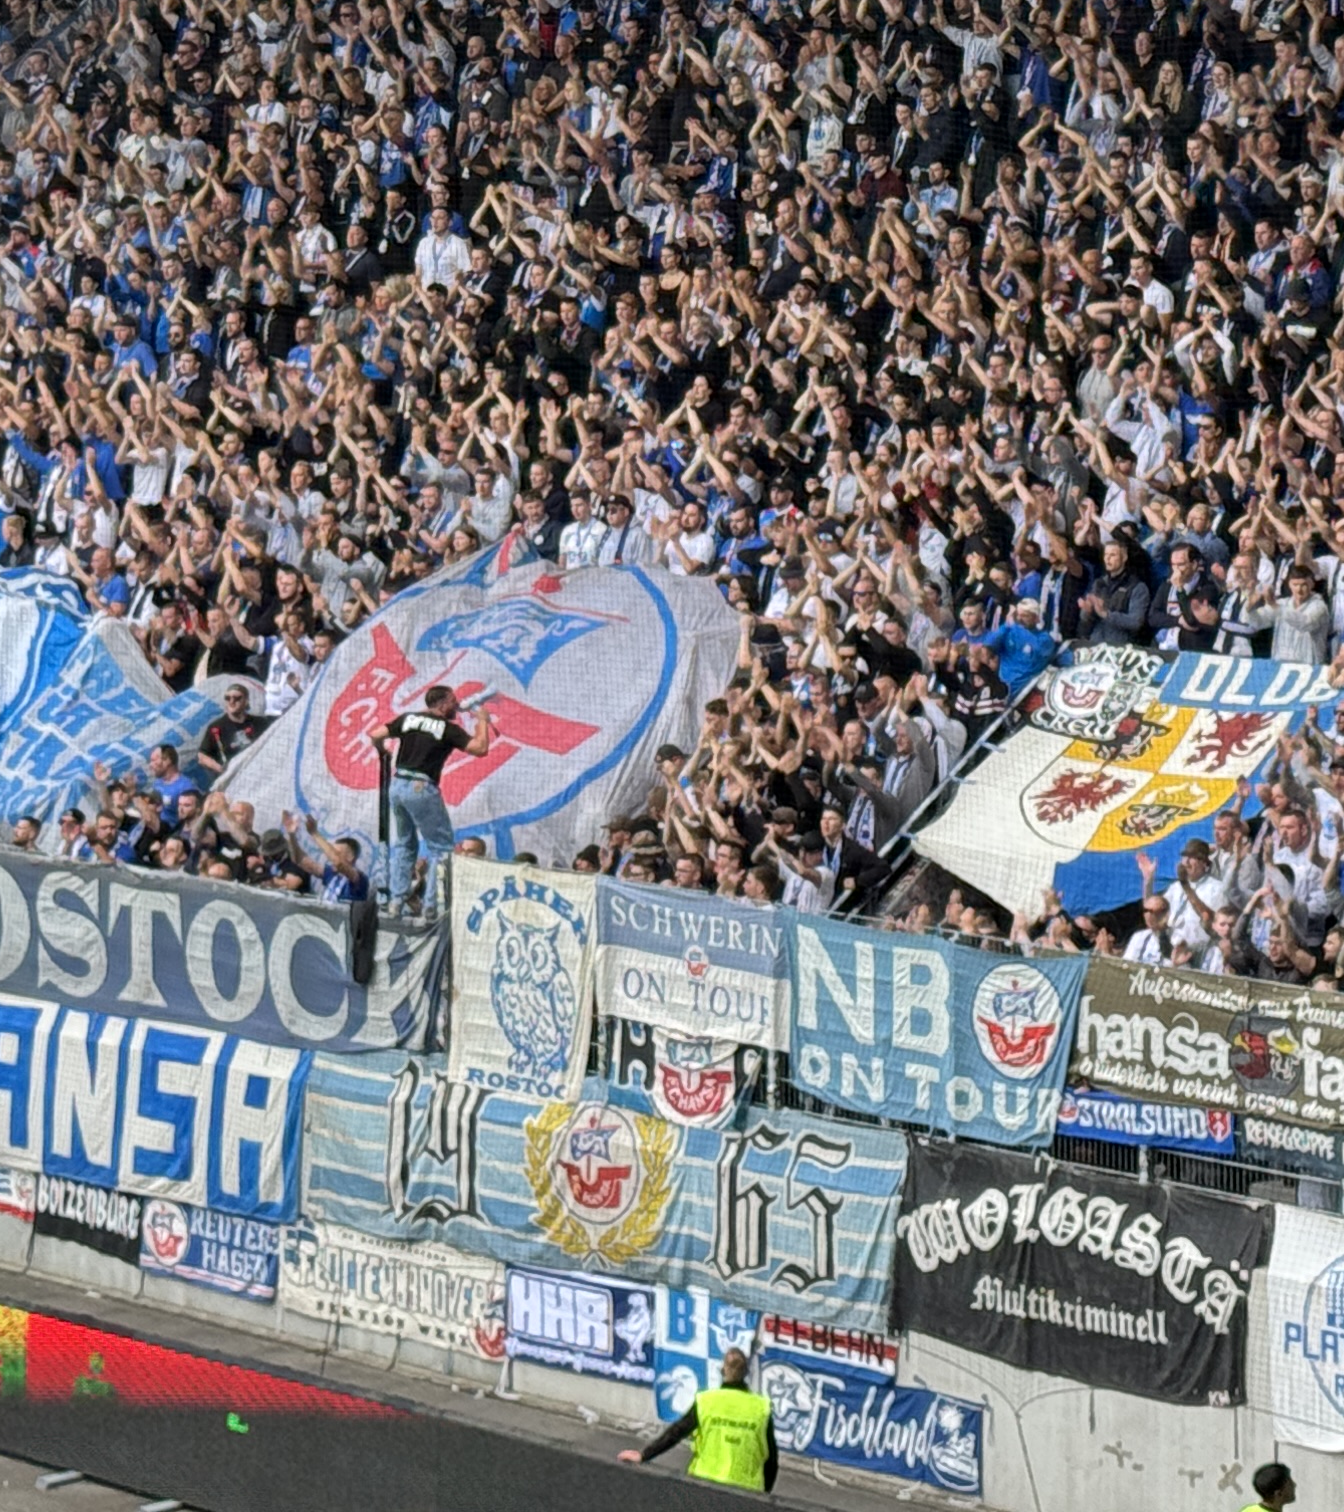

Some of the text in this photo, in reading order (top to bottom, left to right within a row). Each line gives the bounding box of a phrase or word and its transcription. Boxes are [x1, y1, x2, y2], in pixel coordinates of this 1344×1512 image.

[1031, 709, 1118, 740] CREW
[610, 895, 784, 959] SCHWERIN
[622, 967, 667, 1006] ON
[795, 923, 951, 1058] NB
[1076, 994, 1233, 1077] hansa
[798, 1042, 886, 1104] ON
[1077, 1098, 1208, 1140] STRALSUND
[37, 1173, 141, 1240] BOIZENBURG
[509, 1273, 611, 1356] HHR
[970, 1275, 1170, 1346] Multikriminell
[793, 1371, 940, 1468] Fischland
